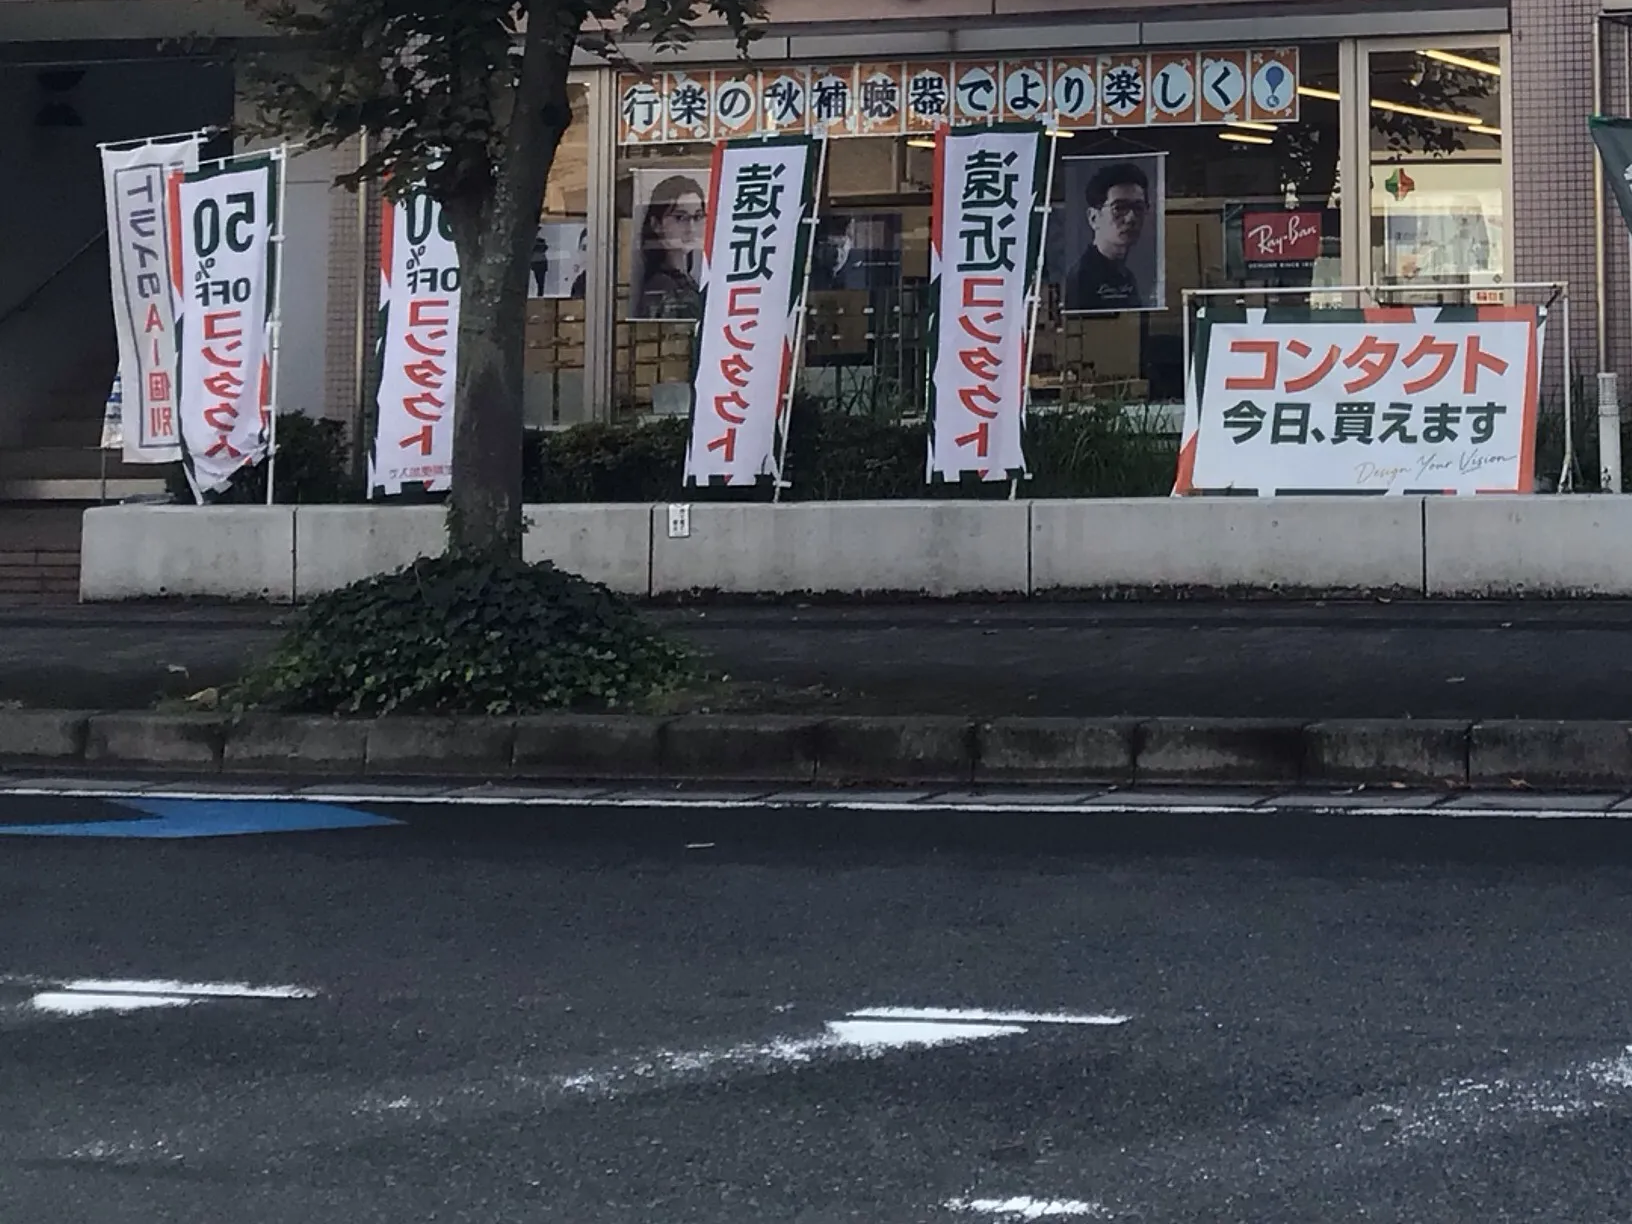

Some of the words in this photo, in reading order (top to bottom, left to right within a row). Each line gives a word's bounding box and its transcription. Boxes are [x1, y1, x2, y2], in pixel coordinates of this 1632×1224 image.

[1248, 215, 1318, 256] Ray-Ban
[1224, 334, 1510, 395] コンタクト
[1222, 399, 1508, 445] 今日、買えます
[1355, 461, 1412, 486] Design
[1416, 451, 1453, 481] Your
[1459, 447, 1518, 475] Vision
